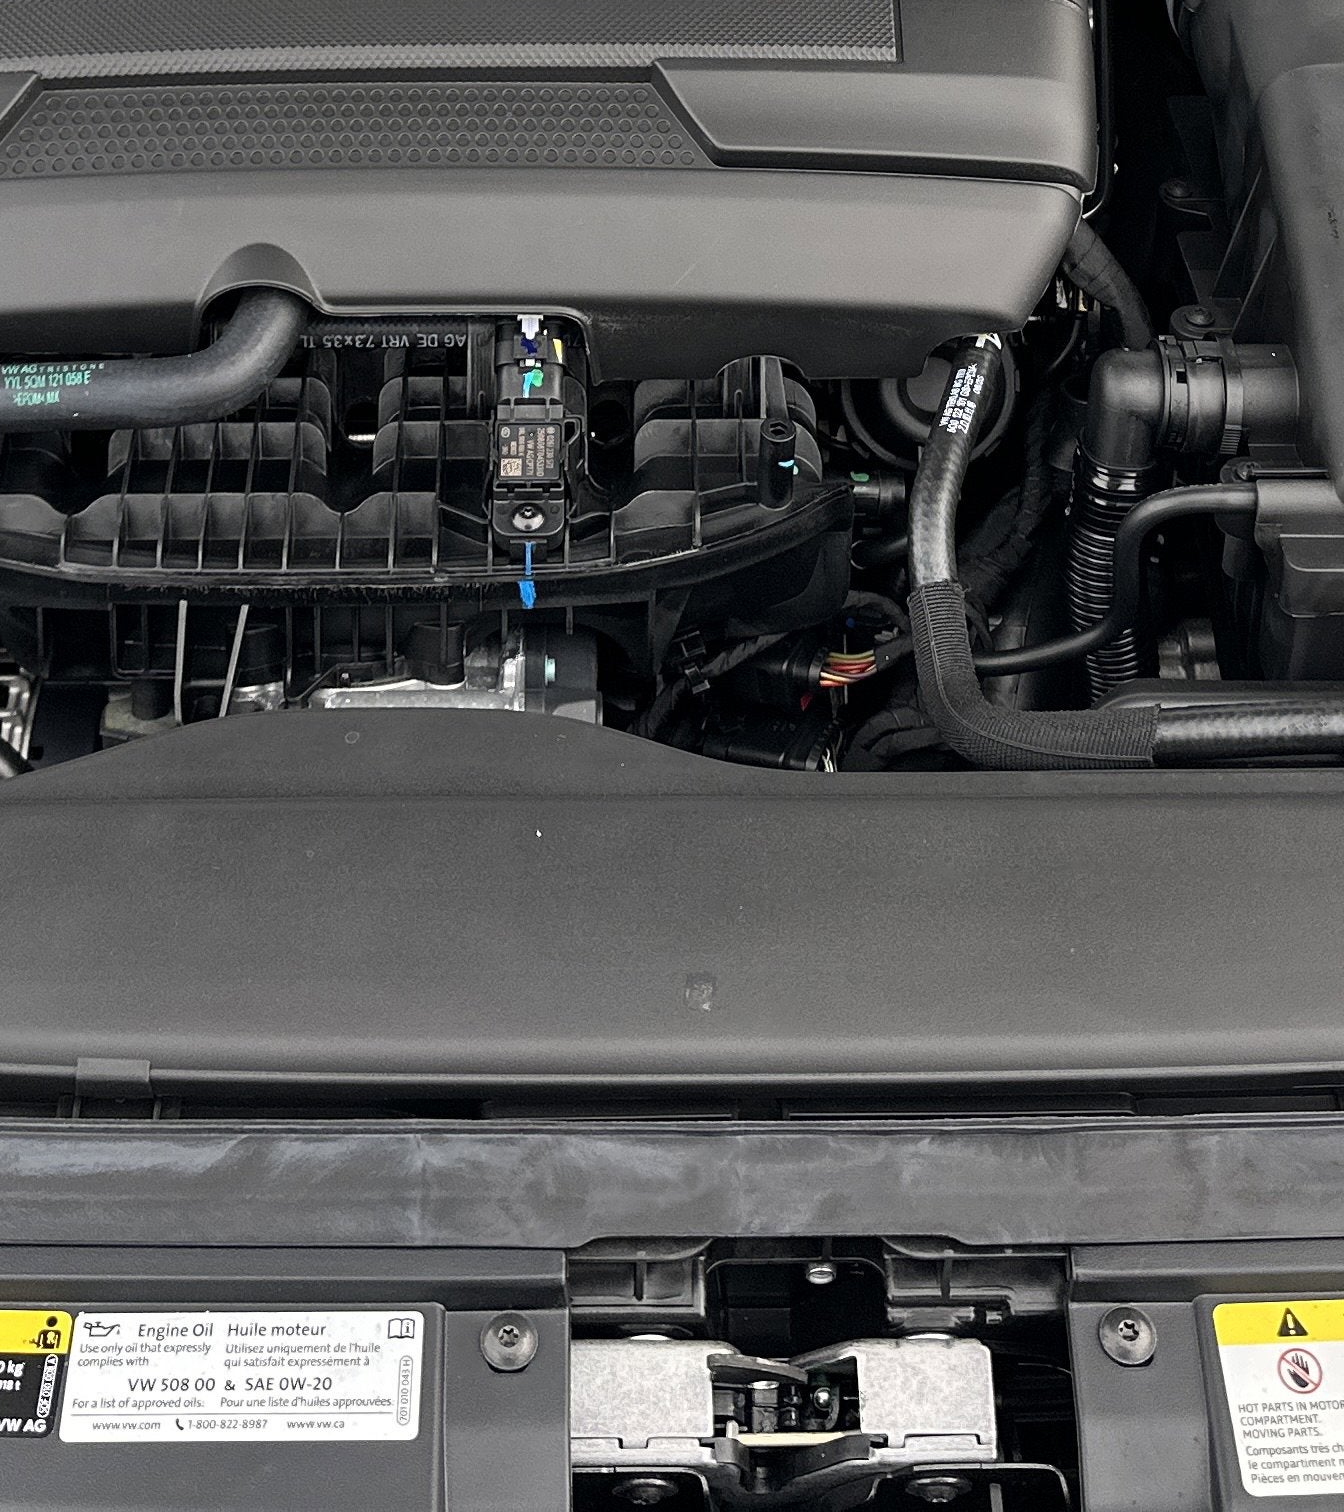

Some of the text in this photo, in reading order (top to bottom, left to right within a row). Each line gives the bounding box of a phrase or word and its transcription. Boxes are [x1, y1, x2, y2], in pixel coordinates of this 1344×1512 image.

[299, 334, 316, 348] TL
[380, 332, 409, 347] VRT
[416, 333, 438, 347] DE
[444, 334, 466, 348] AG
[48, 373, 63, 386] 121
[83, 370, 91, 384] E
[138, 1322, 326, 1341] Engine Oil Huile moteur
[80, 1342, 211, 1356] Use only oil that expressly
[225, 1342, 381, 1356] Utilisez uniquement de l'huile
[77, 1356, 149, 1369] complies with
[224, 1357, 241, 1369] qui
[243, 1356, 286, 1367] satisfait
[363, 1354, 370, 1366] à
[7, 1360, 25, 1378] kg
[128, 1376, 333, 1392] VW 508 00 & SAE 0W-20
[72, 1398, 90, 1409] For
[100, 1397, 116, 1408] list
[118, 1397, 130, 1408] of
[131, 1397, 181, 1411] approved
[220, 1397, 244, 1407] Pour
[246, 1398, 266, 1407] une
[268, 1396, 290, 1407] liste
[1238, 1402, 1260, 1414] HOT
[1262, 1401, 1294, 1412] PARTS
[1296, 1400, 1308, 1411] IN
[23, 1418, 47, 1432] AG
[92, 1421, 161, 1430] www.vw.com
[287, 1420, 345, 1429] www.vw.ca
[1243, 1427, 1285, 1439] MOVING
[1246, 1443, 1309, 1458] Composants
[1248, 1458, 1258, 1470] le
[1261, 1456, 1336, 1471] compartiment
[1251, 1471, 1285, 1484] Pièces
[1287, 1473, 1301, 1482] en
